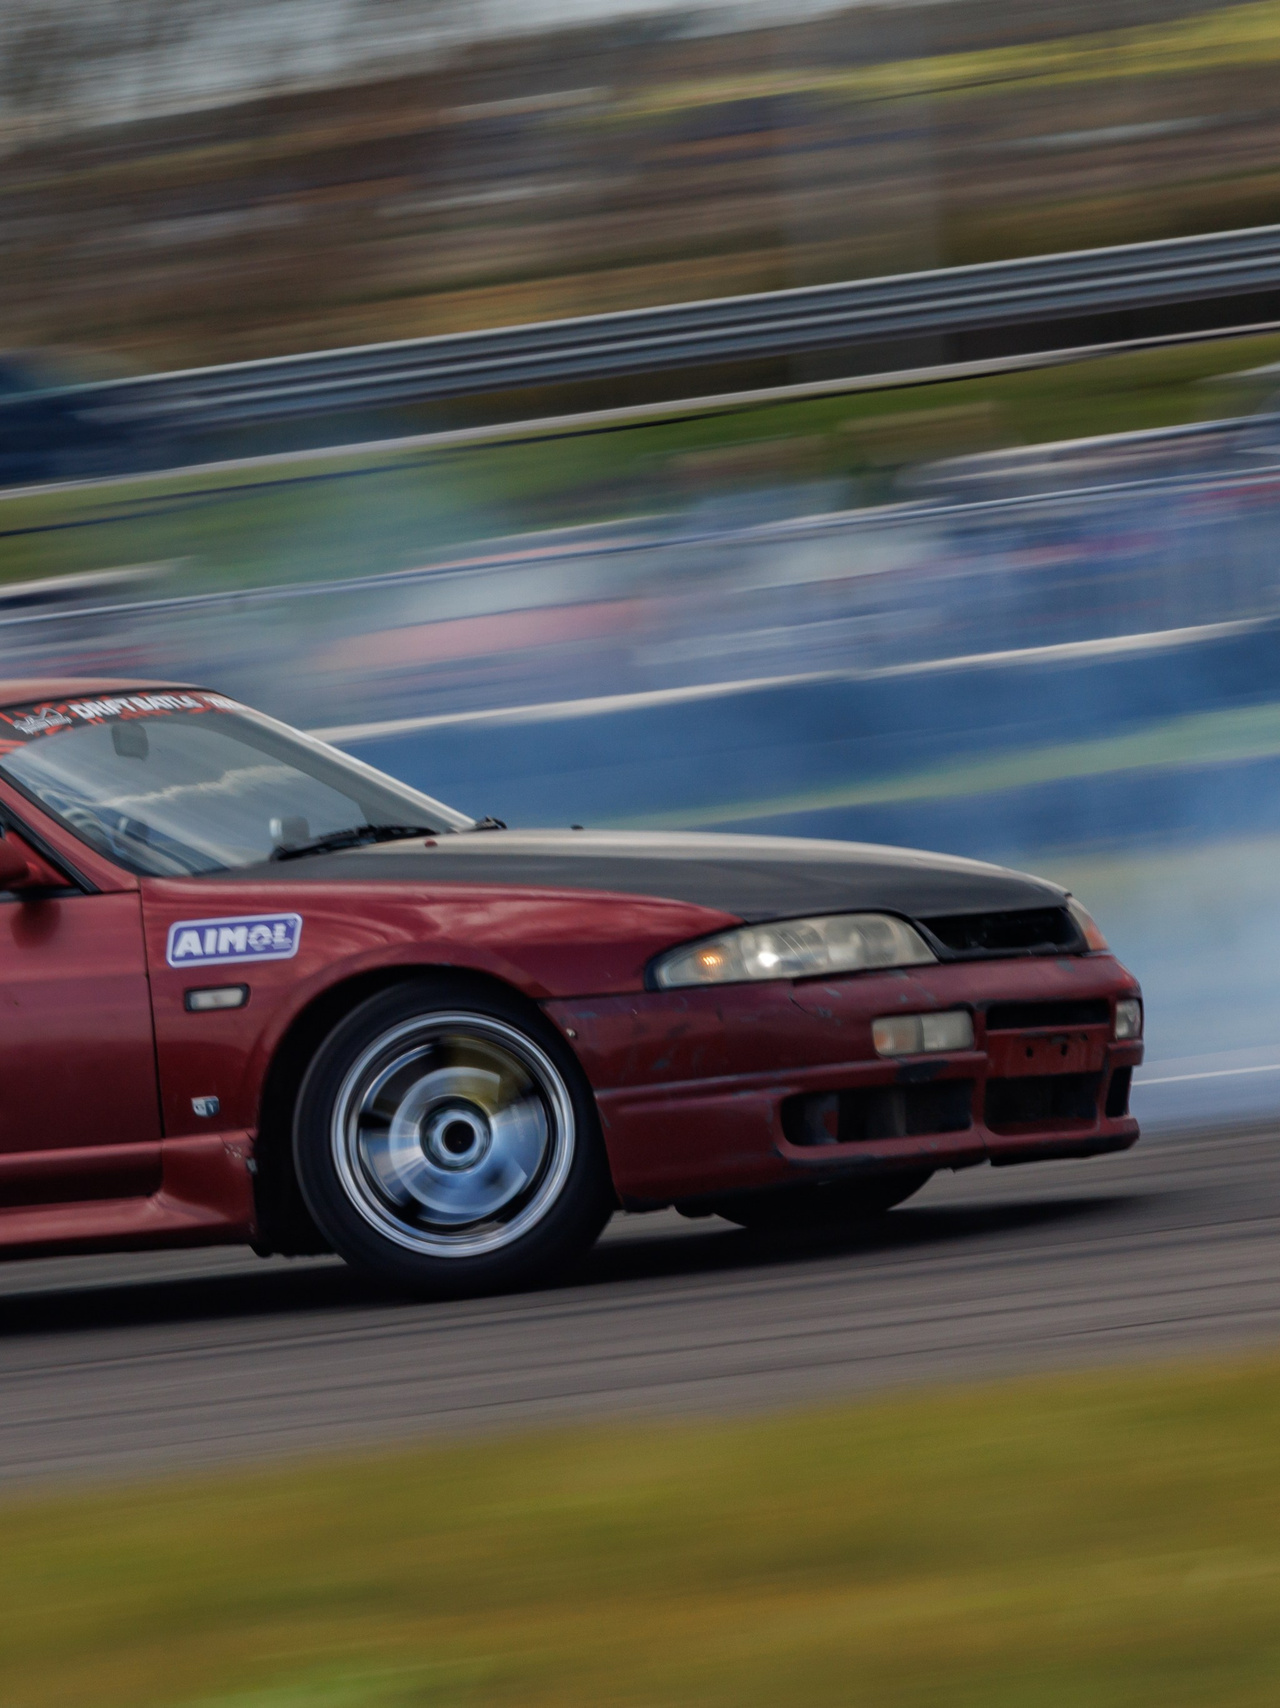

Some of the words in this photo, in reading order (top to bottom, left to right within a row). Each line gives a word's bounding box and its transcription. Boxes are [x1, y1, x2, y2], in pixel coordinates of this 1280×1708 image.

[69, 698, 137, 719] DRIFT
[129, 695, 204, 711] BATTLE
[173, 923, 292, 958] AIMOL
